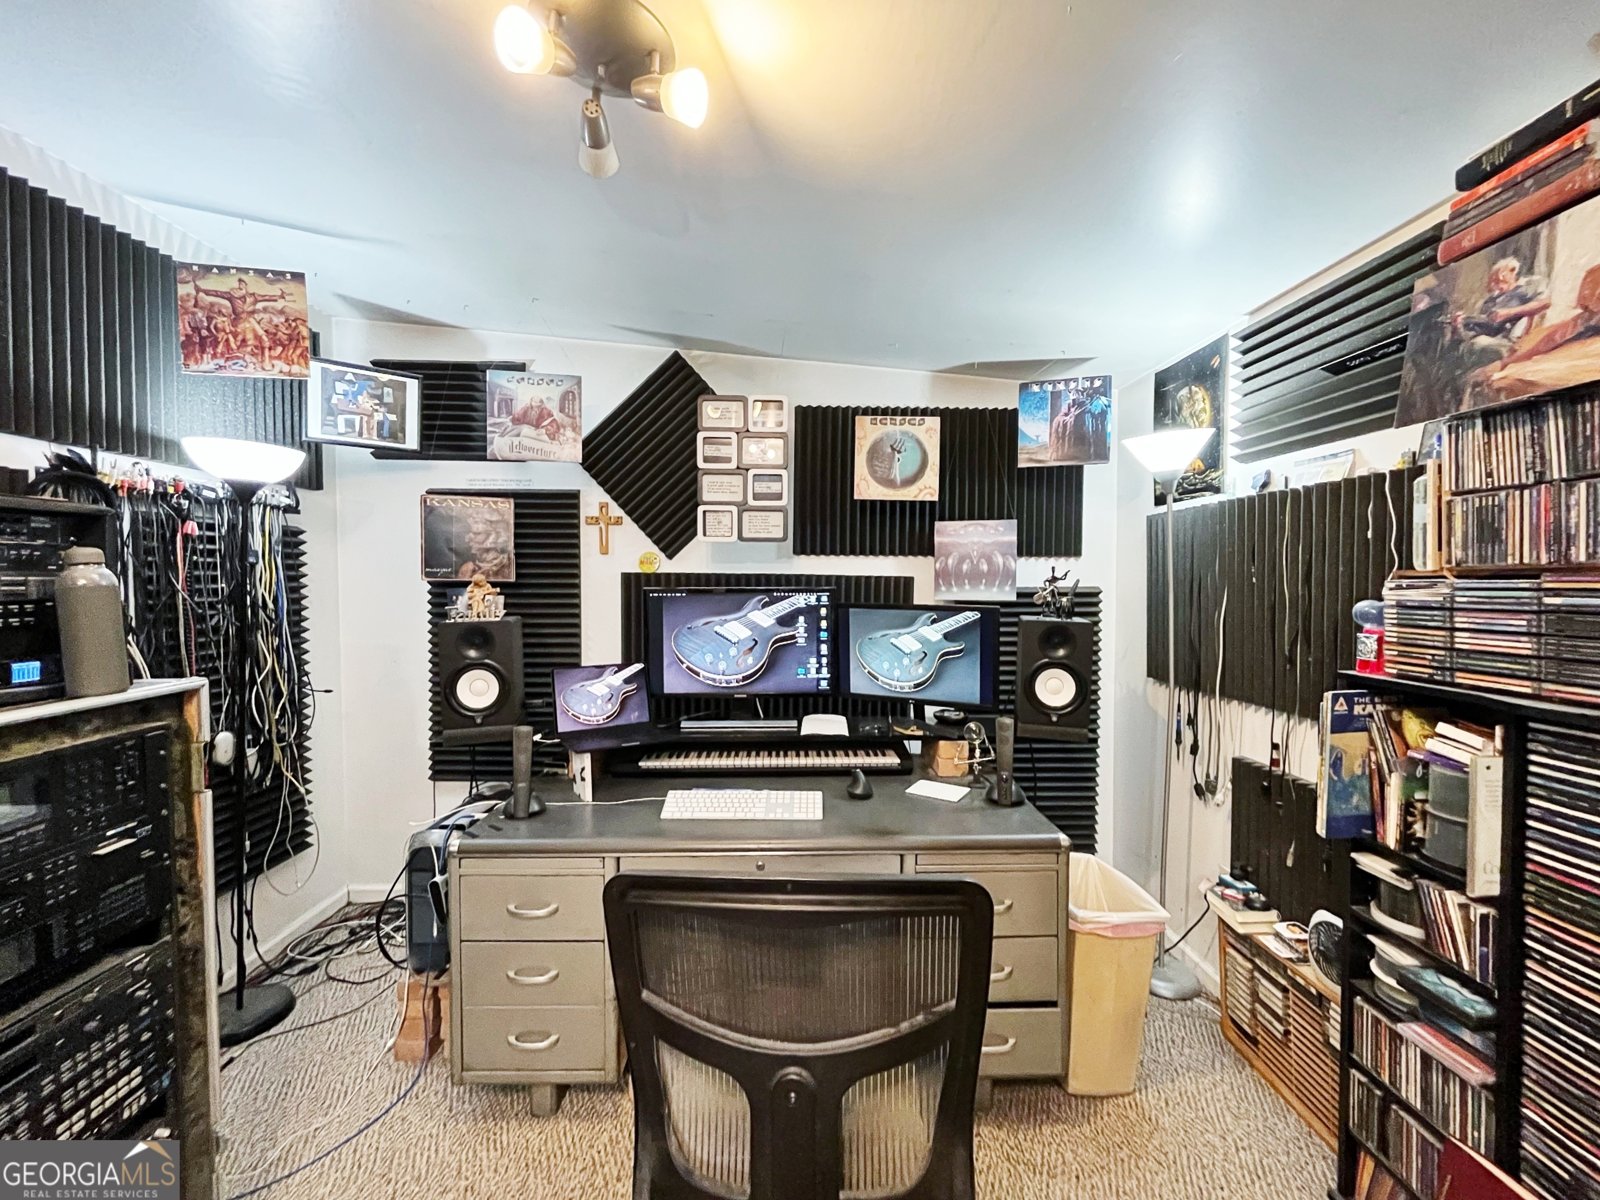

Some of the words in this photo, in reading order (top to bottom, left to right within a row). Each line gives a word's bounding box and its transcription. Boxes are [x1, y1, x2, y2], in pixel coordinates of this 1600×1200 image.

[192, 265, 292, 279] KANSAS
[426, 497, 510, 509] KANSAS
[1353, 696, 1371, 704] THE
